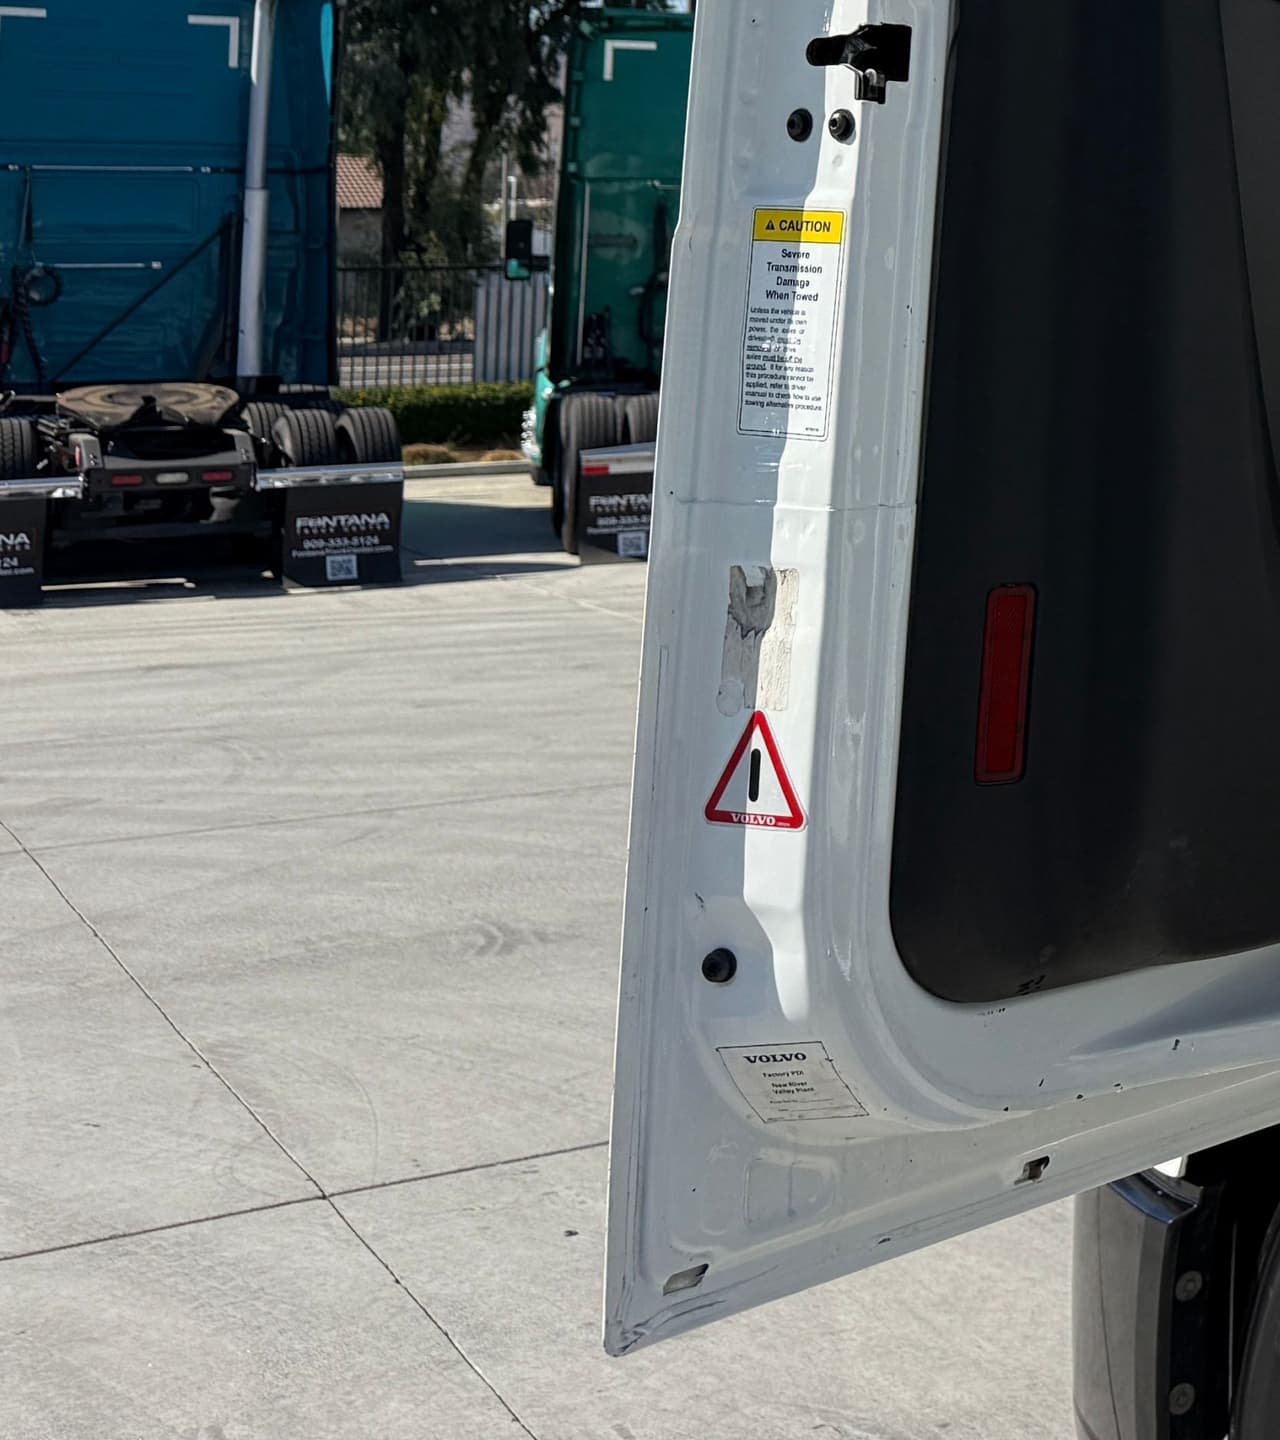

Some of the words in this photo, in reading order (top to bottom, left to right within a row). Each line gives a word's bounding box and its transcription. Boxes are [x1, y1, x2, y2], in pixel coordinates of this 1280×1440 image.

[779, 220, 831, 233] CAUTION
[781, 249, 810, 259] Severe
[767, 262, 823, 274] Transmission
[776, 276, 810, 289] Damage
[766, 290, 790, 301] When
[792, 291, 819, 302] Towed
[296, 512, 390, 528] FONTANA
[731, 813, 776, 826] VOLVO
[743, 1052, 807, 1064] VOLVO
